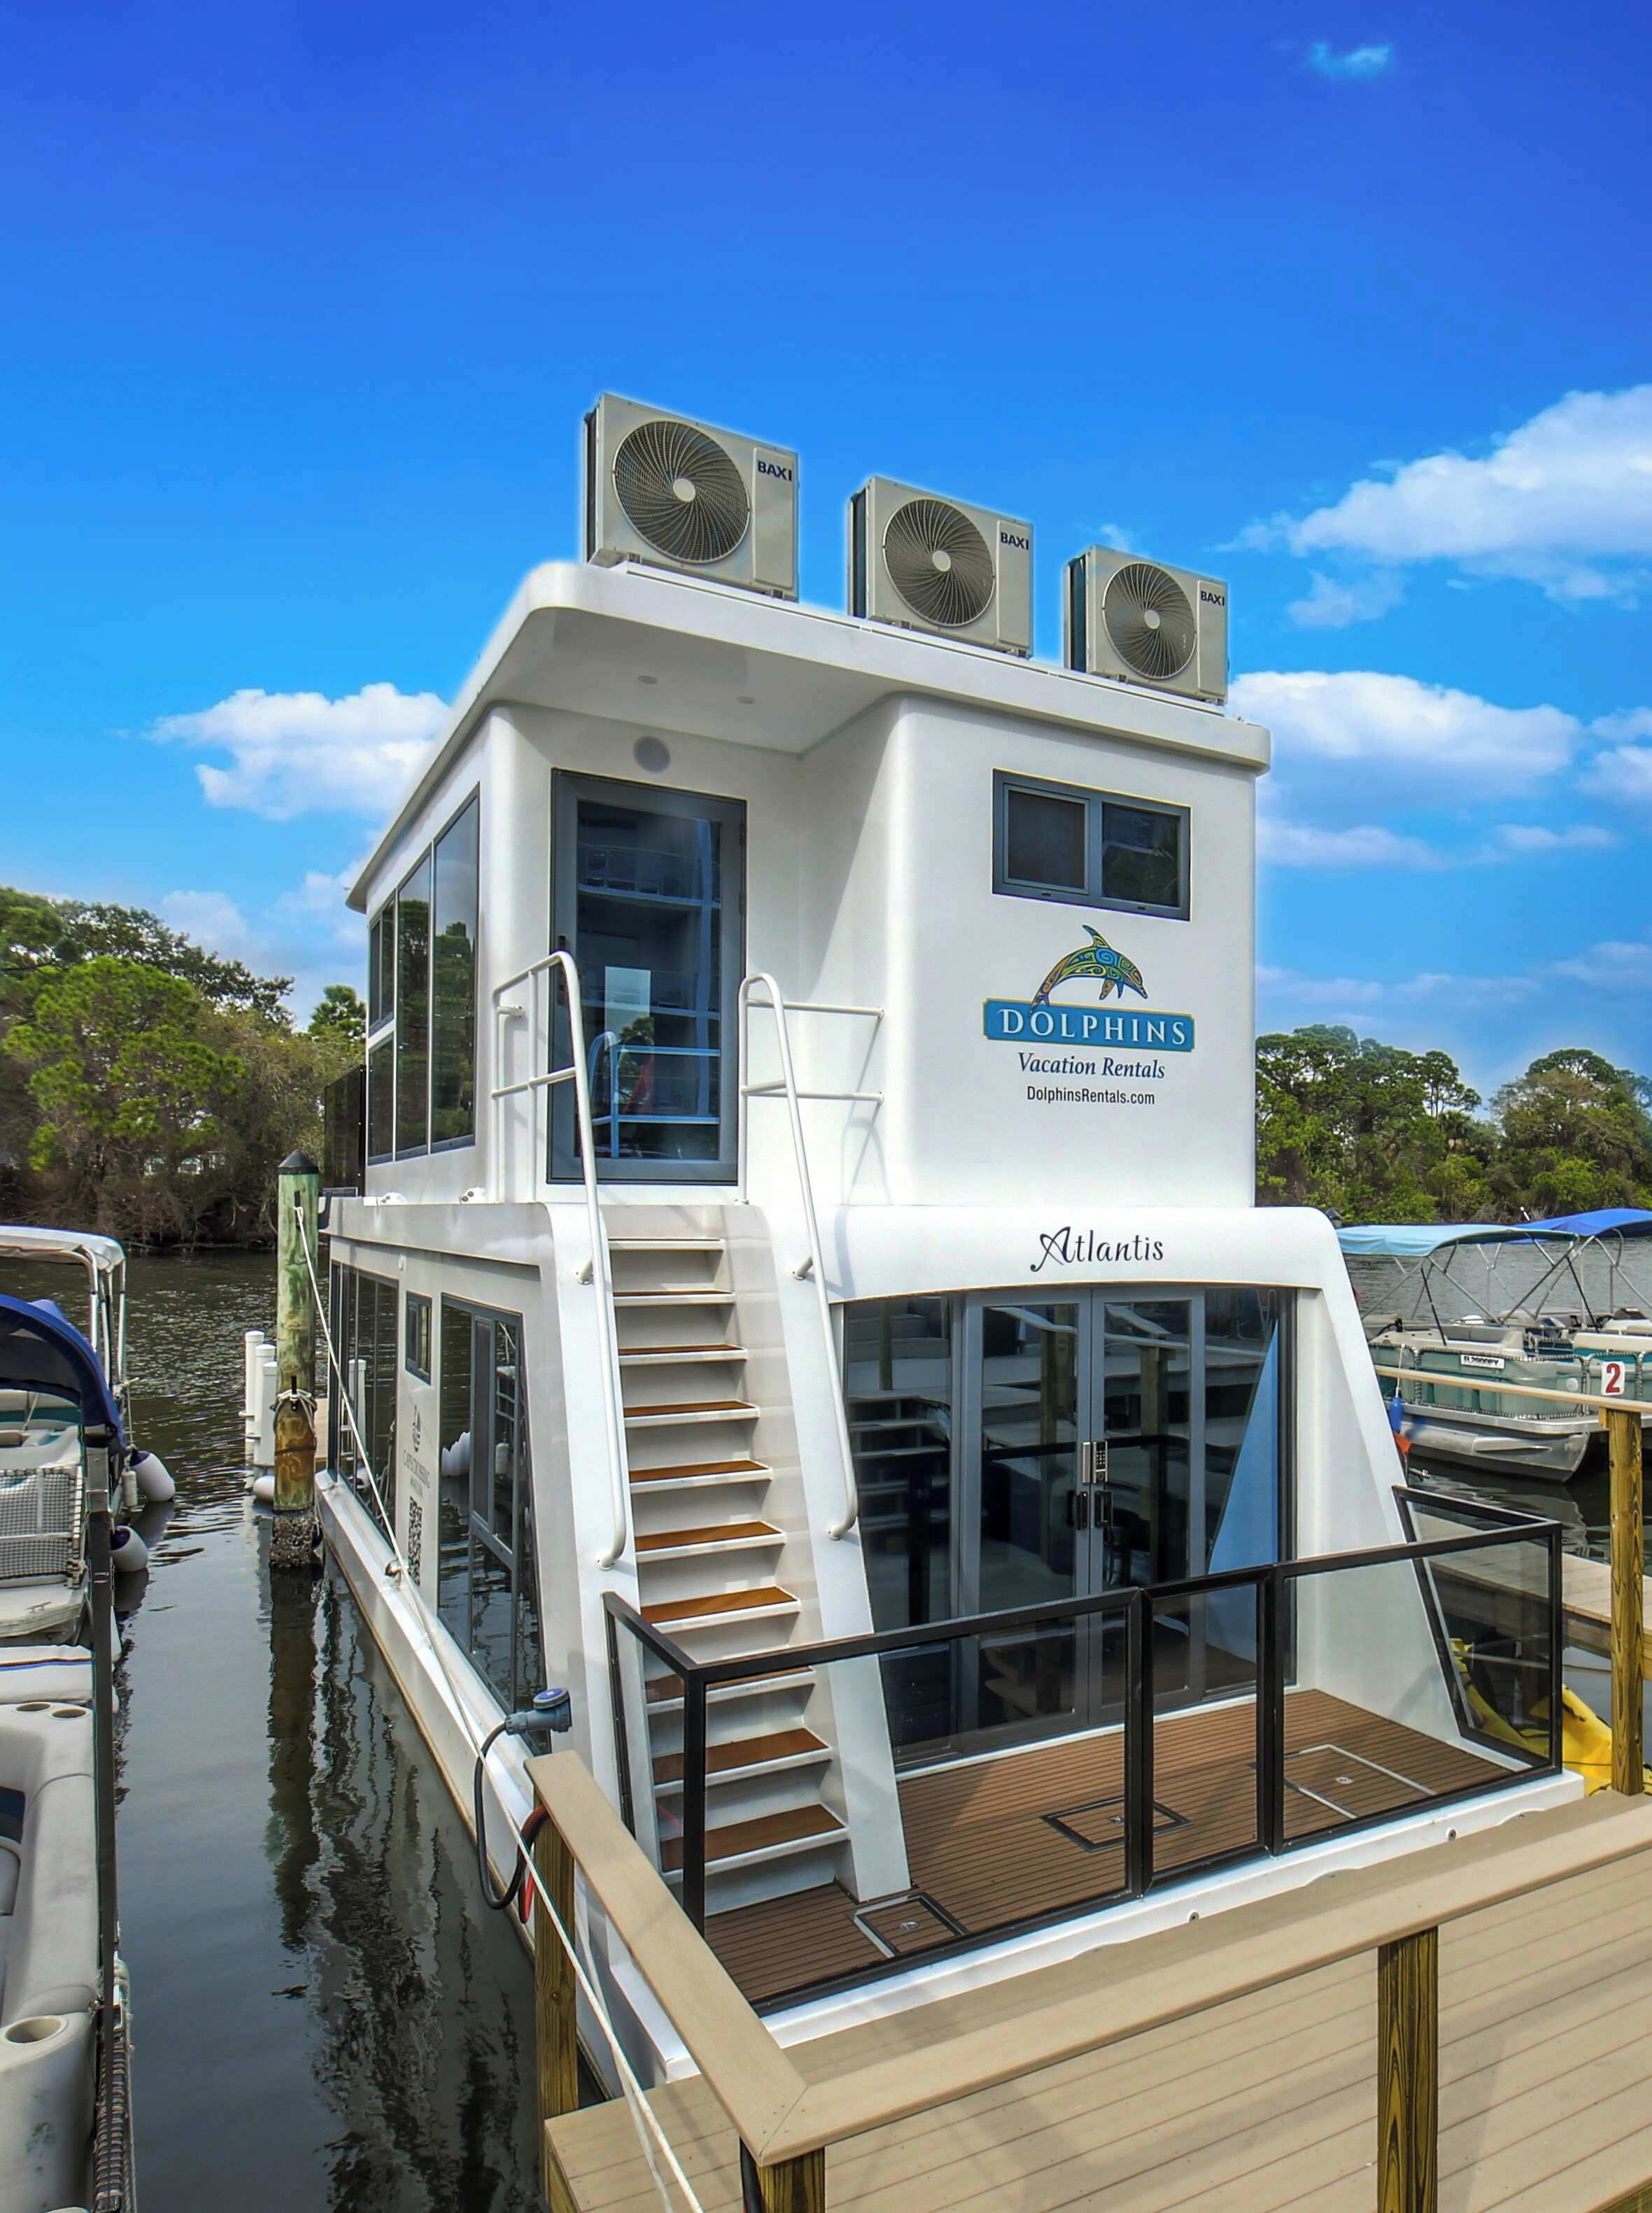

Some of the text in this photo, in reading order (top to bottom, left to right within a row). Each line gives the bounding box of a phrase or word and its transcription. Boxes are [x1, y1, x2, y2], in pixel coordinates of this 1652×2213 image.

[757, 460, 792, 482] BAXI
[1001, 532, 1029, 551] BAXI
[1201, 591, 1224, 607] BAXI
[997, 1008, 1186, 1045] DOLPHINS
[1017, 1052, 1166, 1079] Vacation Rentals
[1027, 1085, 1155, 1105] DolphinsRentals.com
[1030, 1226, 1164, 1272] Atlantis
[1606, 1362, 1621, 1393] 2
